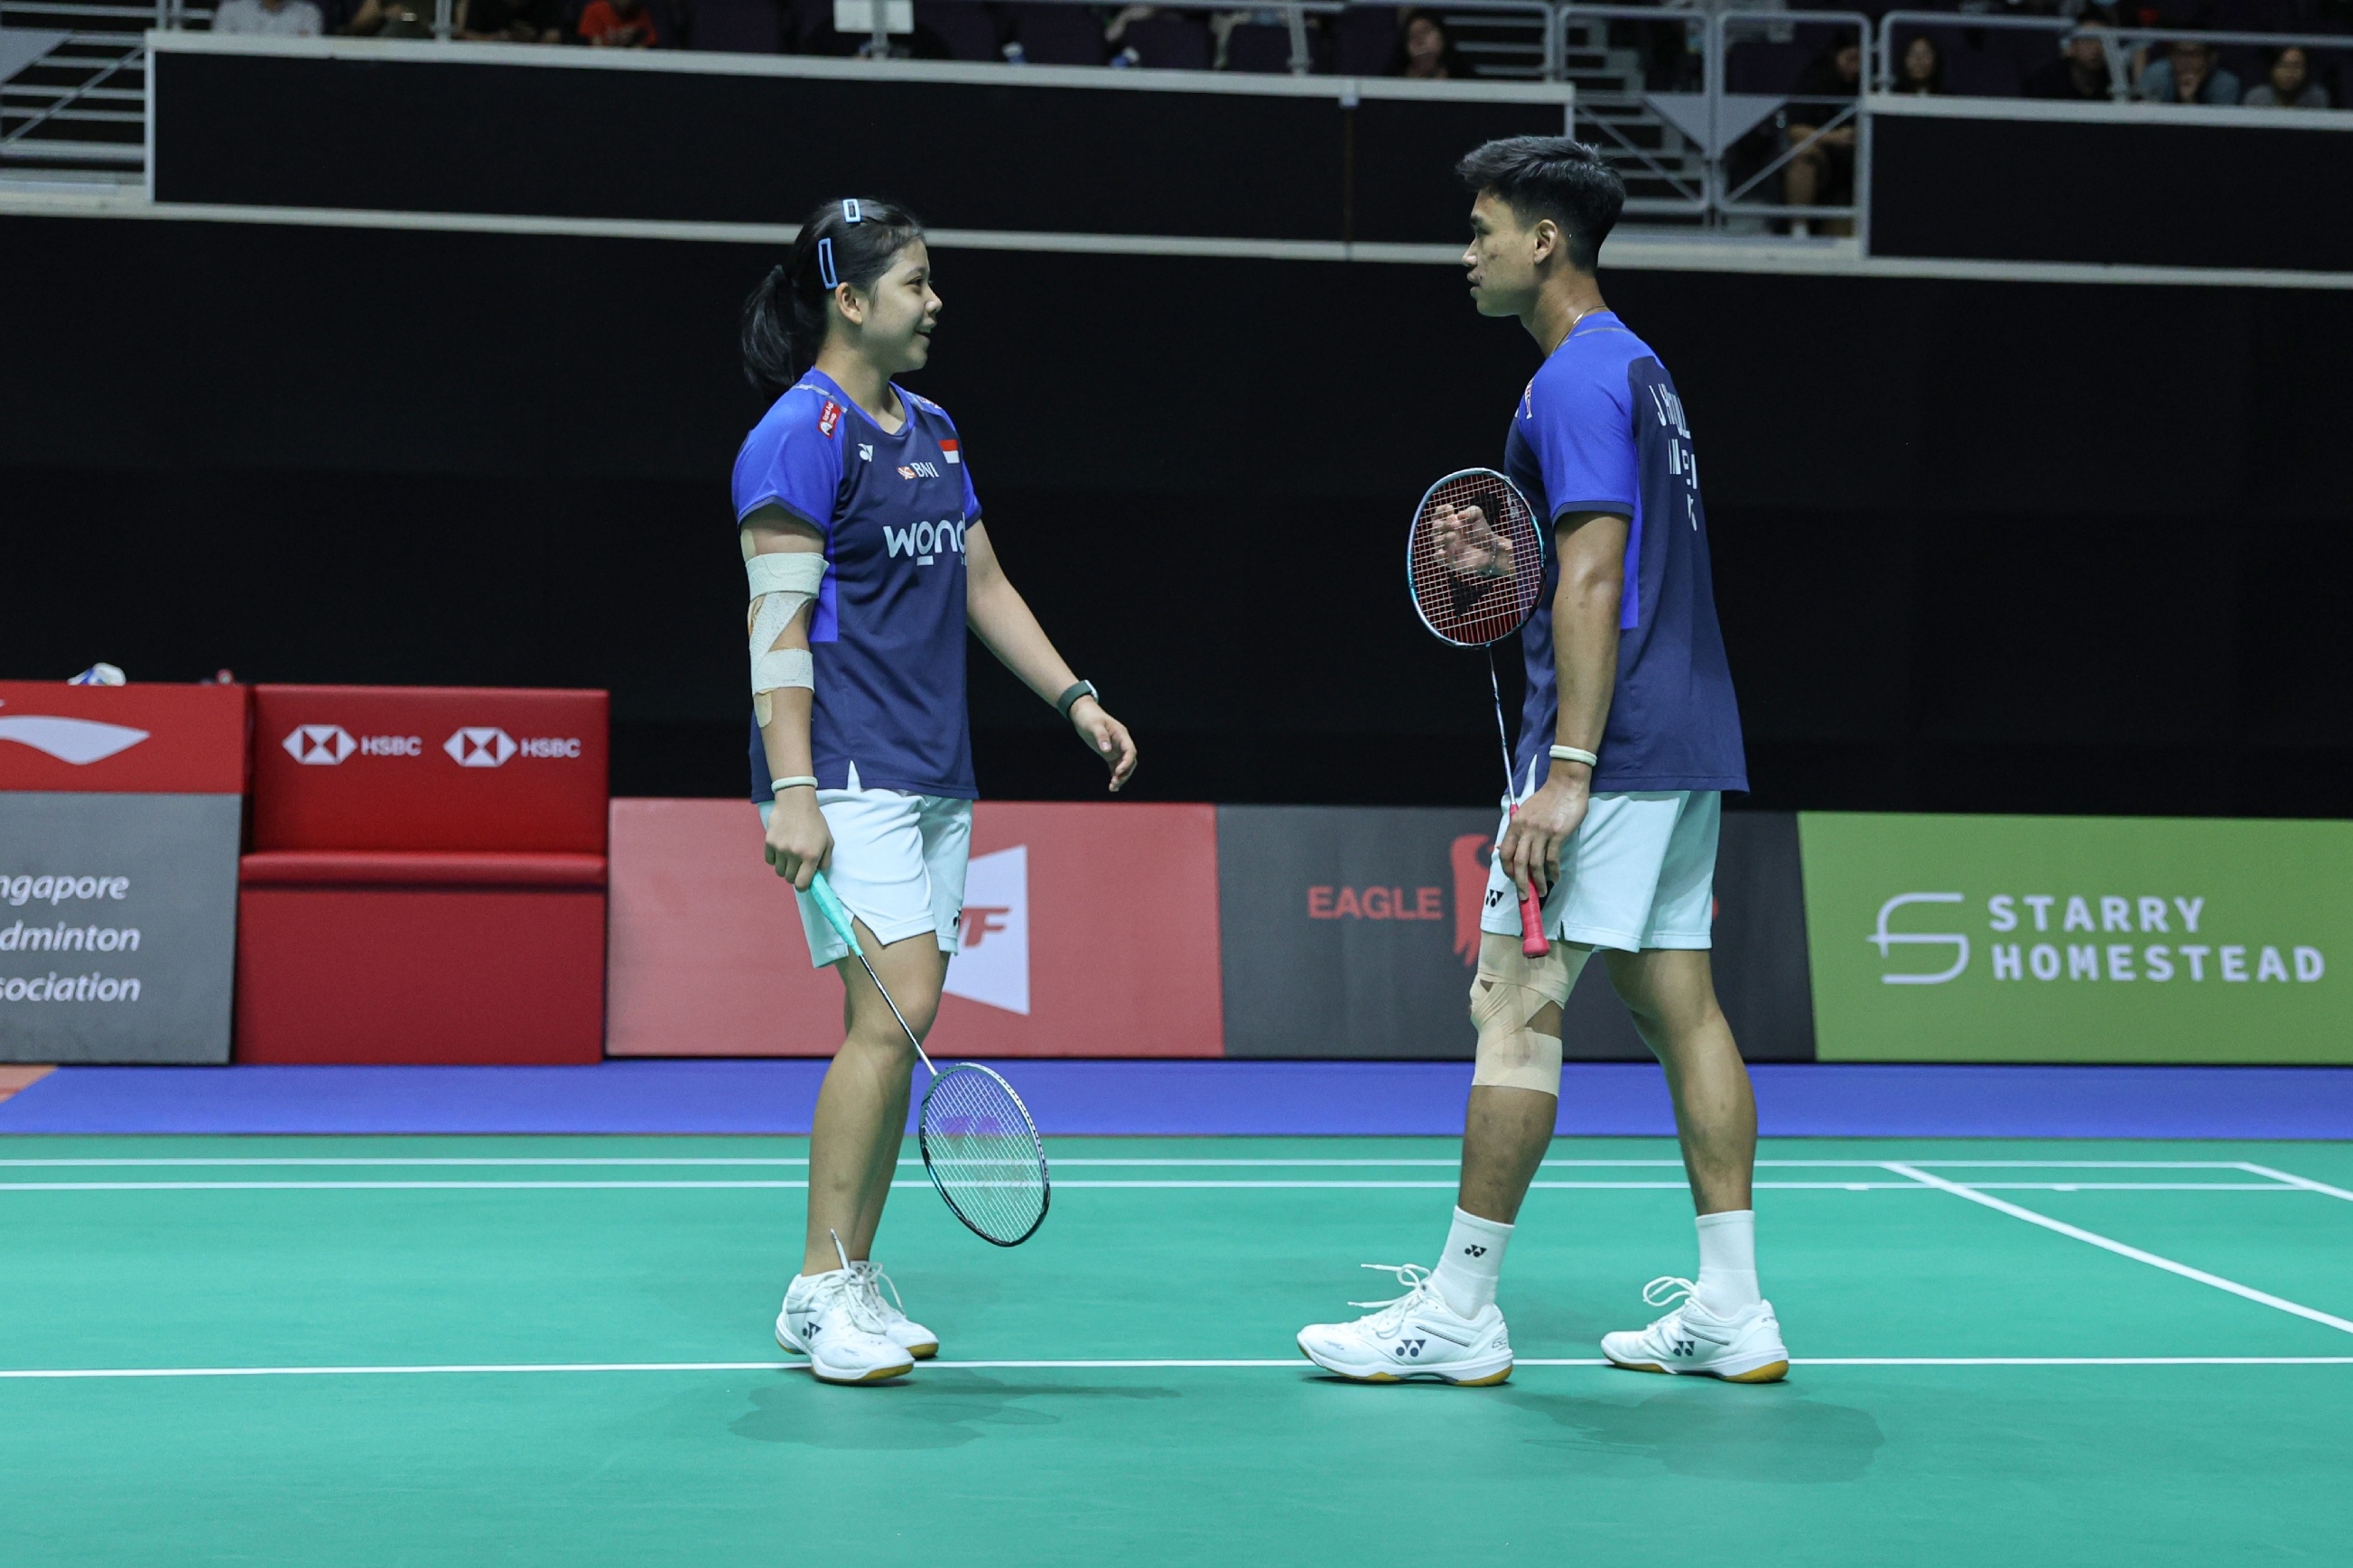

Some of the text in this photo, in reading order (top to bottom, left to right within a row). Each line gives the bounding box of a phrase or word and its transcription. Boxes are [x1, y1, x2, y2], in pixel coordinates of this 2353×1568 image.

[909, 461, 940, 478] BNI
[361, 736, 422, 756] HSBC
[520, 738, 581, 758] HSBC
[1308, 886, 1443, 920] EAGLE
[1987, 895, 2205, 933] STARRY
[0, 921, 142, 951] dminton
[1991, 943, 2326, 983] HOMESTEAD
